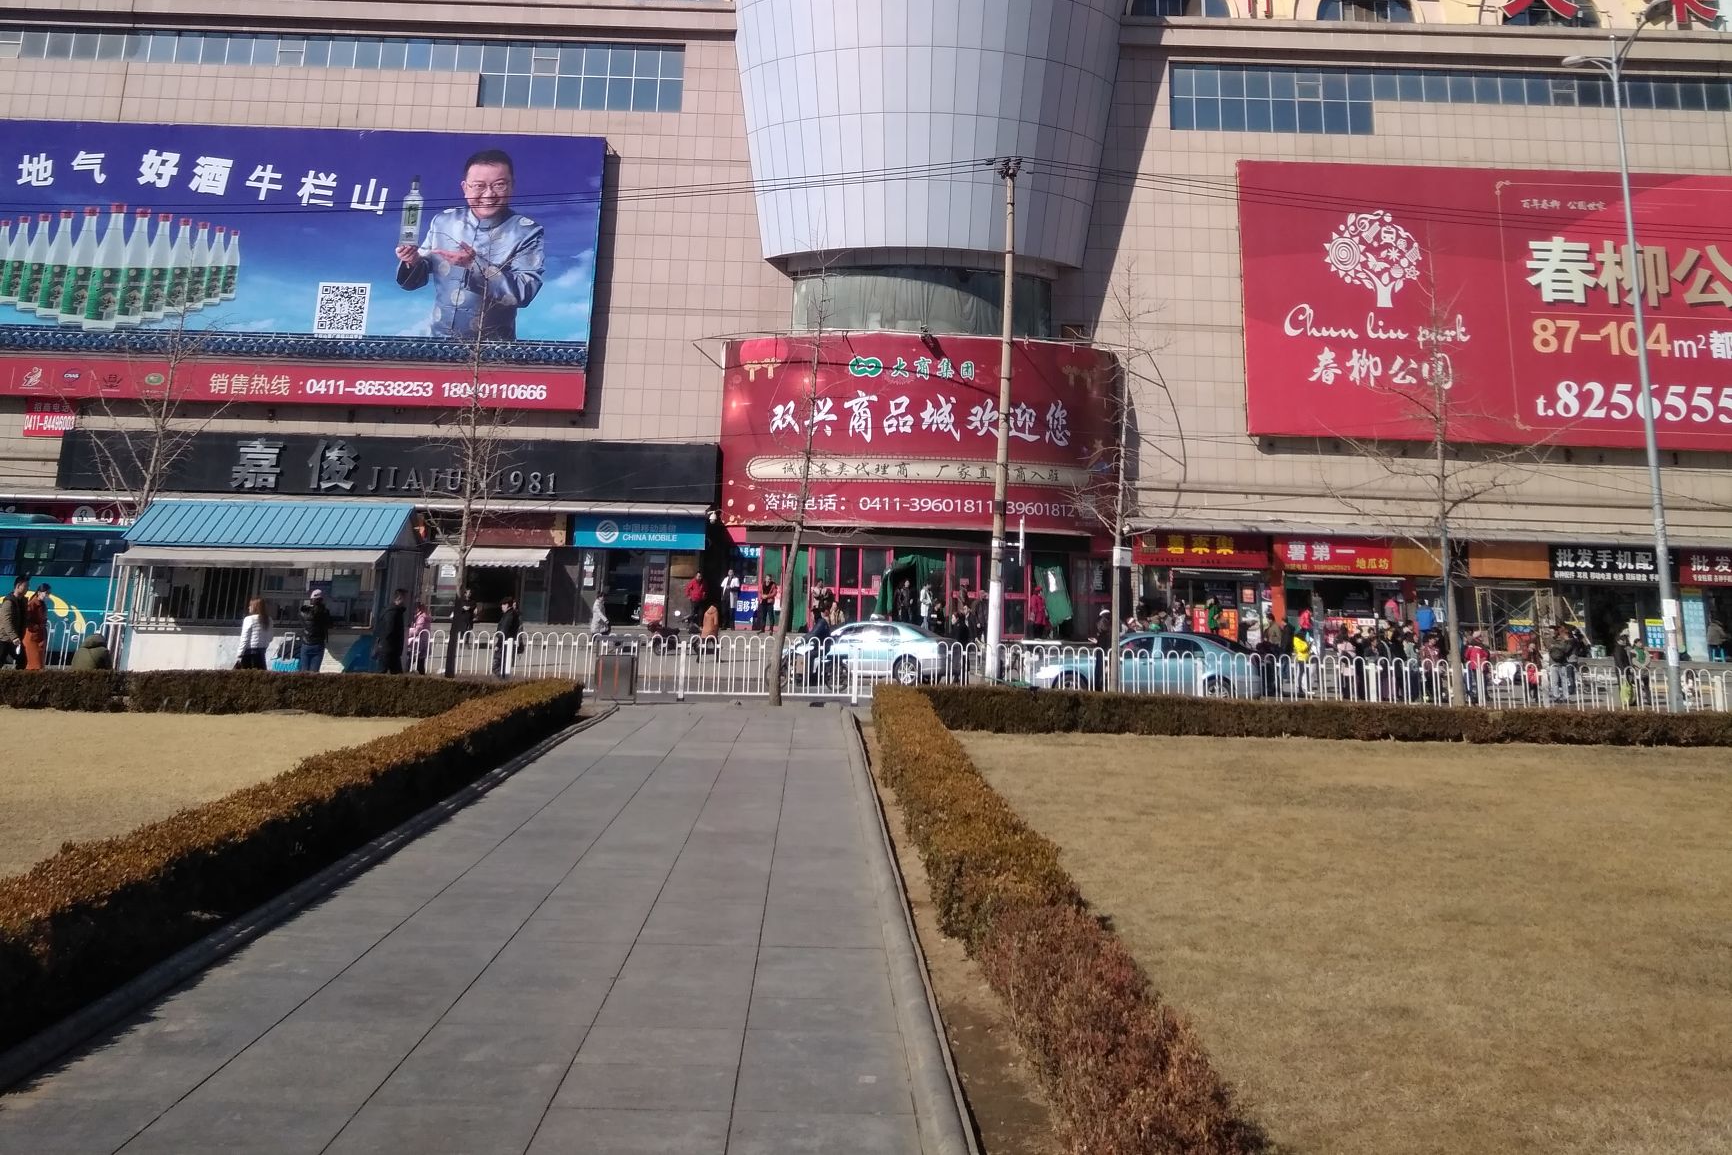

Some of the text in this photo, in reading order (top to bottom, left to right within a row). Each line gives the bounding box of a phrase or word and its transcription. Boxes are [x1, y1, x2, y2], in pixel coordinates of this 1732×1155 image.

[1284, 303, 1471, 349] Chun liu park
[890, 356, 976, 381] 大商集团
[367, 466, 557, 495] JIAJU 1981
[622, 533, 678, 542] CHINA MOBILE
[1287, 541, 1356, 562] 薯第一
[1355, 557, 1389, 570] 地瓜坊
